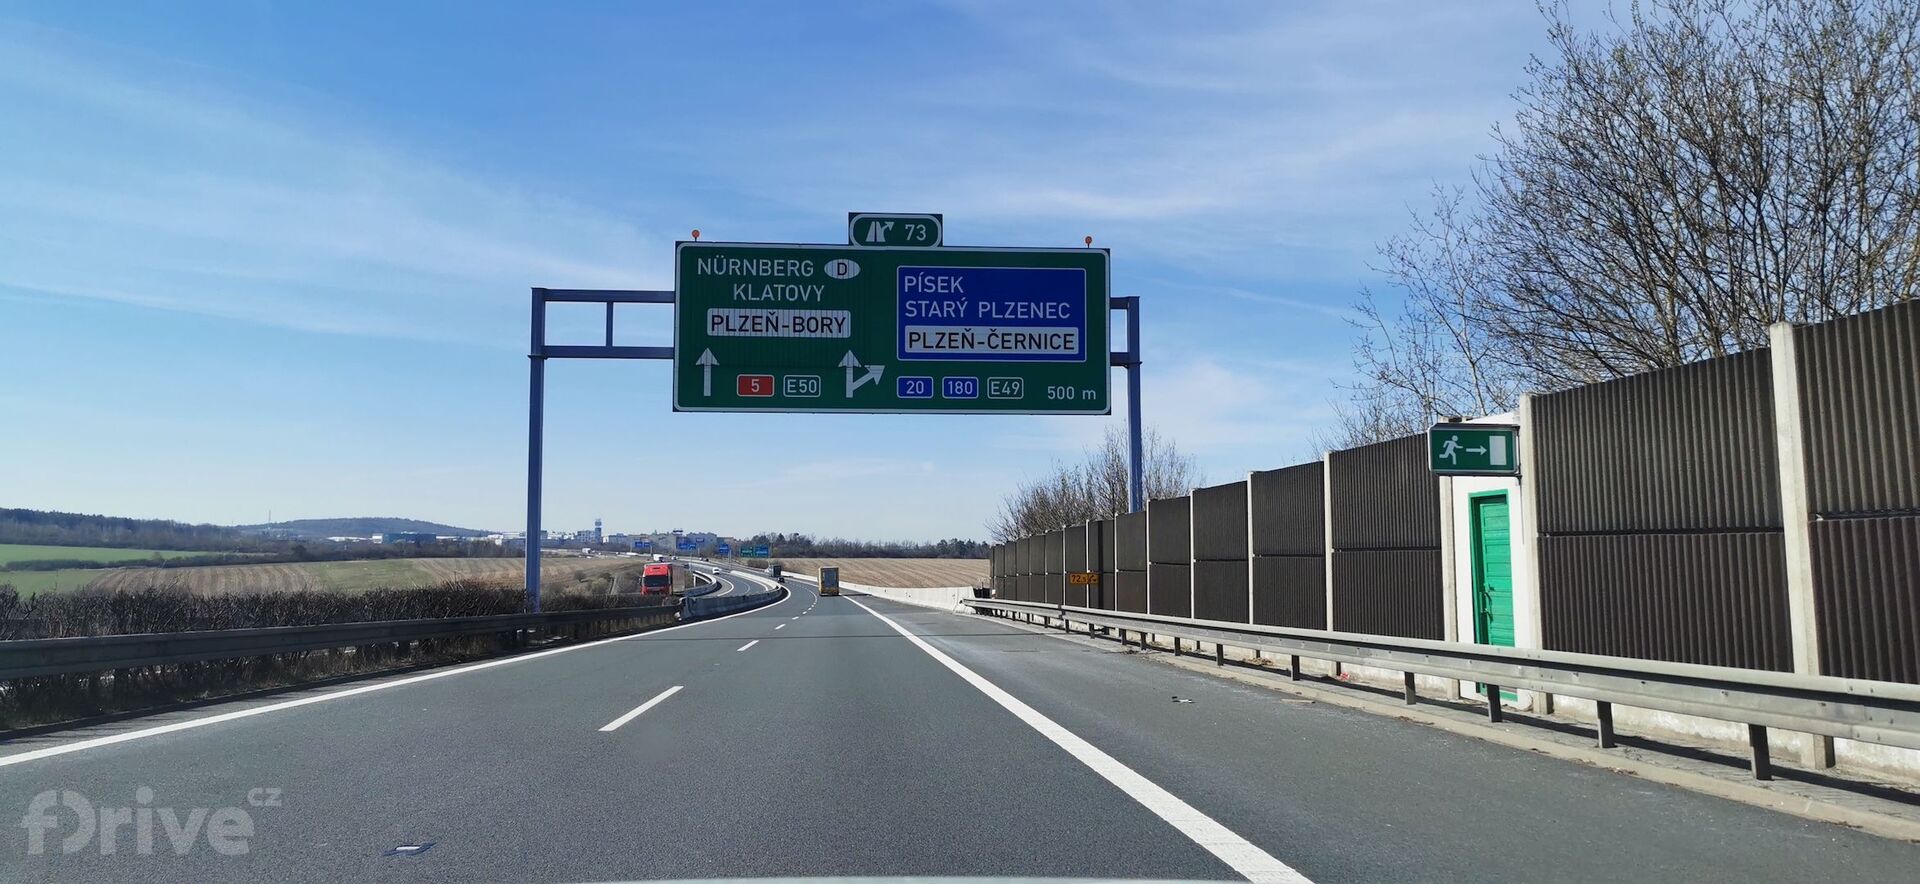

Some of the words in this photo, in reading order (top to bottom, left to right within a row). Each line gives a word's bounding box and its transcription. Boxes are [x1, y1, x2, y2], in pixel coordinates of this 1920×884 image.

[905, 225, 926, 240] 73
[697, 255, 813, 276] NÜRNBERG
[837, 262, 847, 275] D
[905, 272, 963, 292] PÍSEK
[733, 283, 825, 302] KLATOVY
[905, 297, 967, 318] STARÝ
[978, 301, 1070, 319] PLZENEC
[711, 312, 846, 334] PLZEŇ-BORY
[909, 329, 1075, 349] PLZEŇ-ČERNICE
[751, 379, 760, 392] 5
[787, 380, 817, 393] E50
[906, 381, 924, 394] 20
[947, 381, 972, 394] 180
[991, 381, 1019, 395] E49
[1048, 386, 1075, 399] 500
[1082, 389, 1096, 399] m
